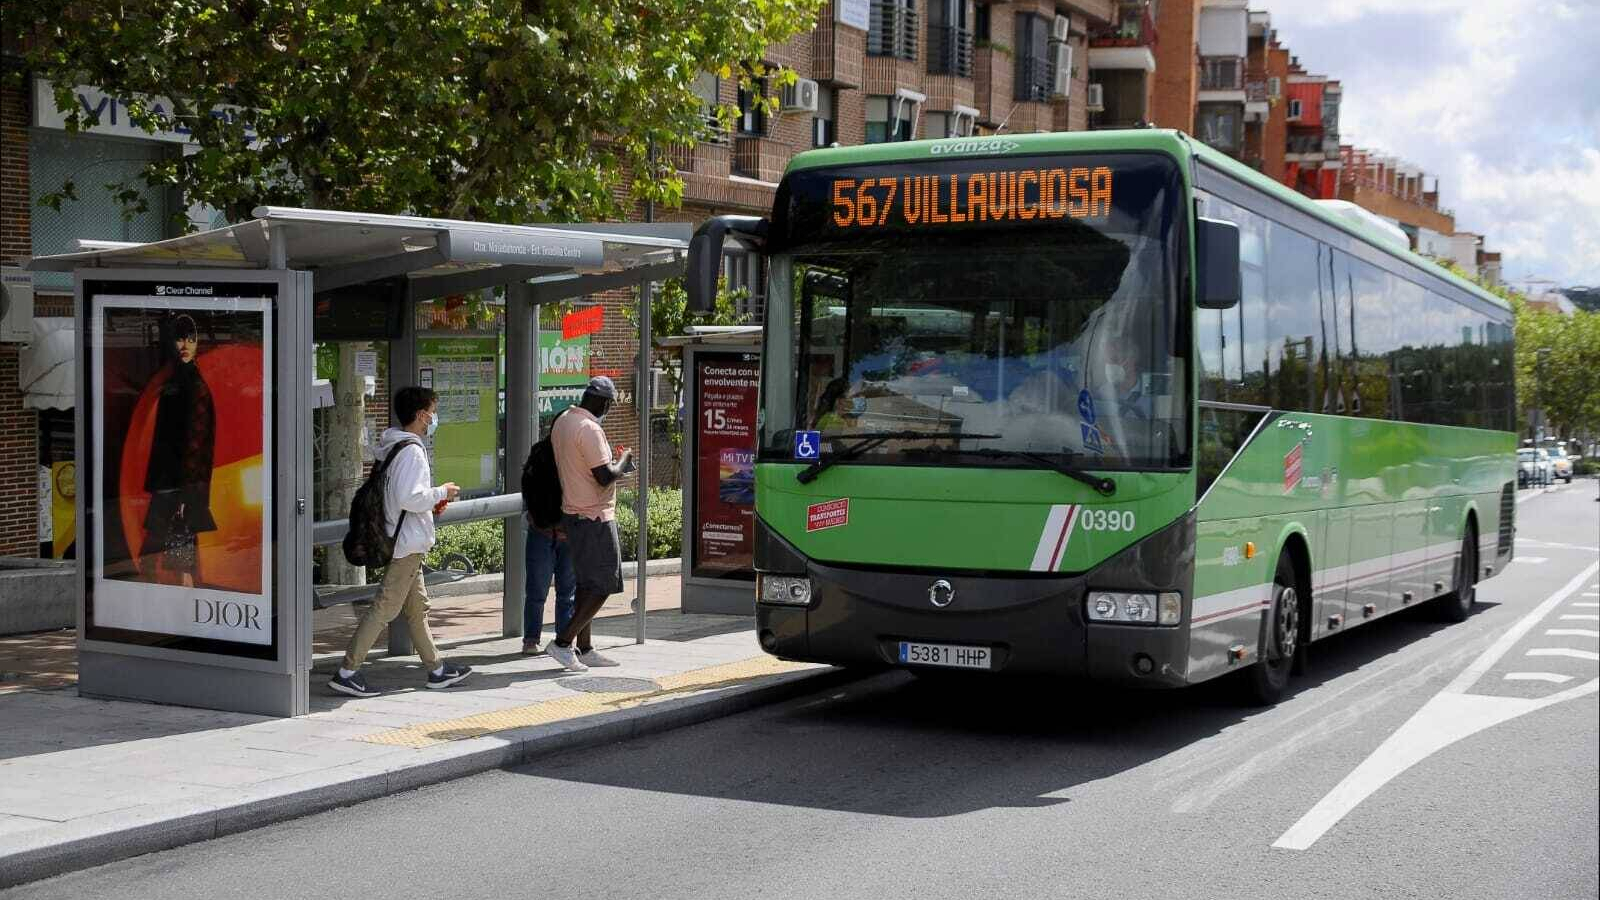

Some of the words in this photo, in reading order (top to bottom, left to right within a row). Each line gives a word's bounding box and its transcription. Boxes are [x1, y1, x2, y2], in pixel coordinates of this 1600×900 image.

[931, 139, 1002, 154] avanza
[832, 177, 897, 227] 567
[904, 166, 1112, 224] VILLAVICIOSA
[166, 286, 184, 295] Clear
[185, 286, 213, 295] Channel
[538, 340, 583, 373] IÓN
[704, 366, 737, 376] Conecta
[704, 377, 749, 387] envolvente
[704, 409, 726, 429] 15
[735, 453, 748, 463] TV
[1081, 509, 1136, 532] 0390
[192, 598, 262, 631] DIOR
[911, 645, 950, 663] 5381
[956, 648, 987, 666] HHP
